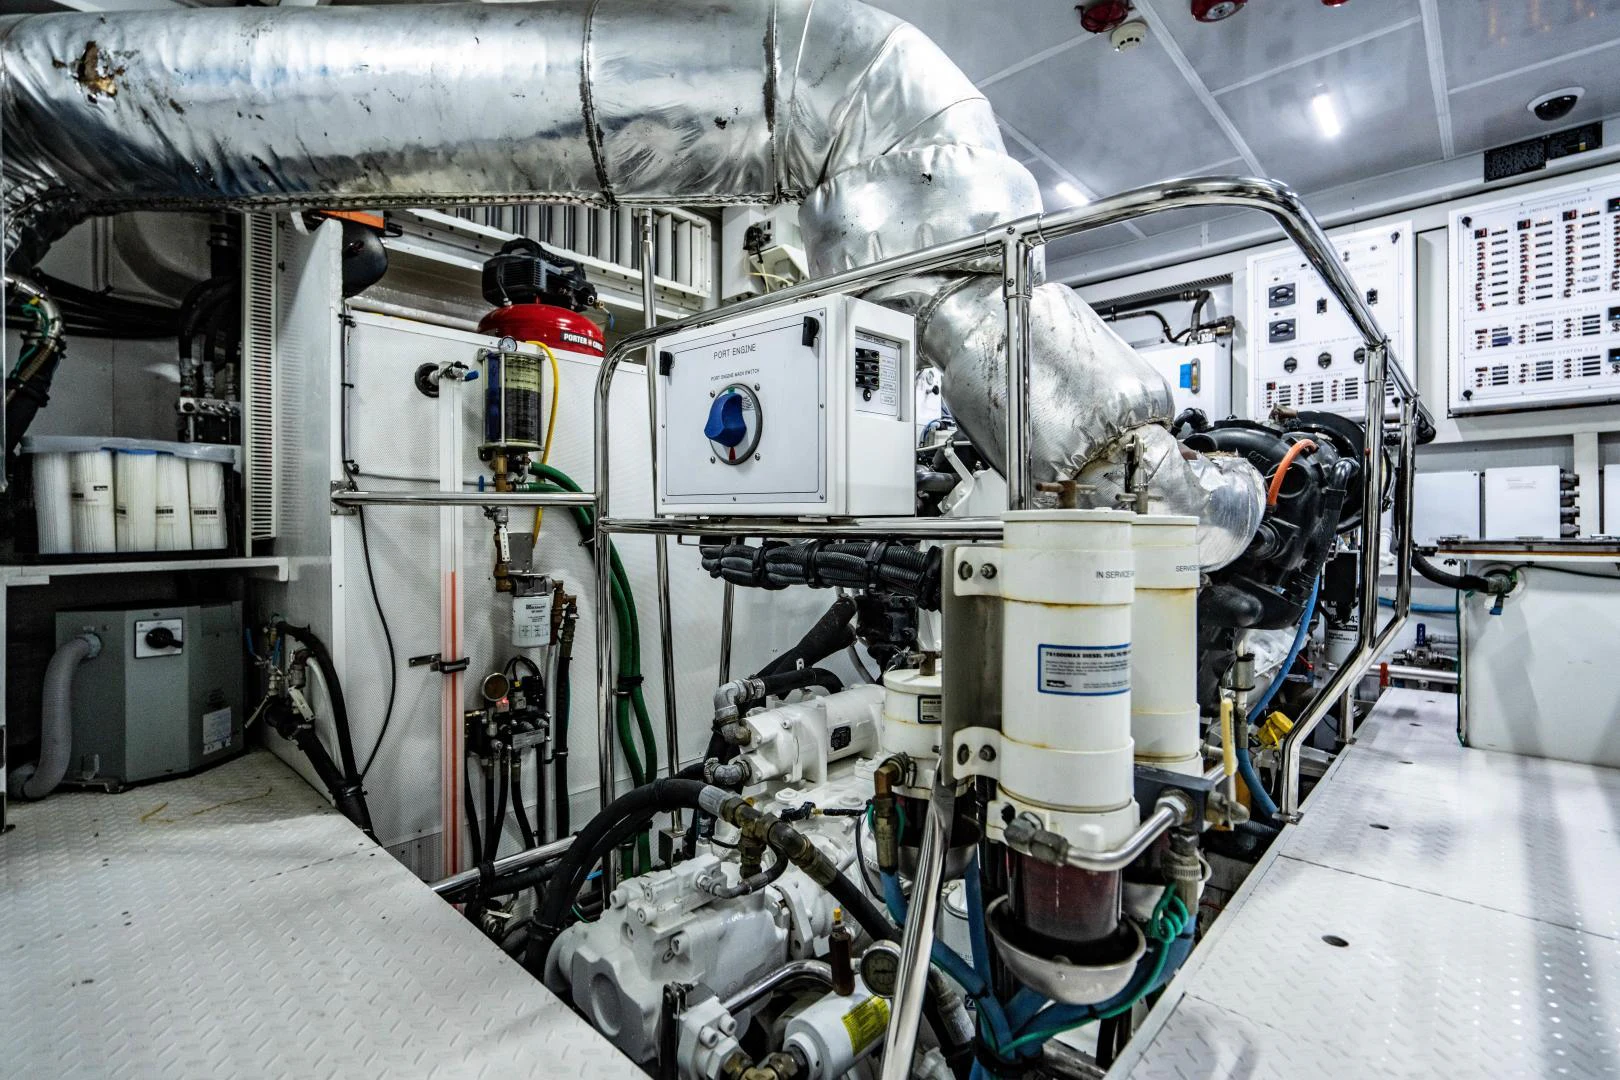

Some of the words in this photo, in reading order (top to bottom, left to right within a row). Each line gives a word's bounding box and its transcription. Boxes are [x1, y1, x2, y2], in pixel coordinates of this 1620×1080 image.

[563, 333, 588, 345] PORTER
[713, 348, 730, 360] PORT
[732, 343, 756, 356] ENGINE
[721, 372, 734, 380] ENGINE
[745, 368, 759, 378] SWITCH
